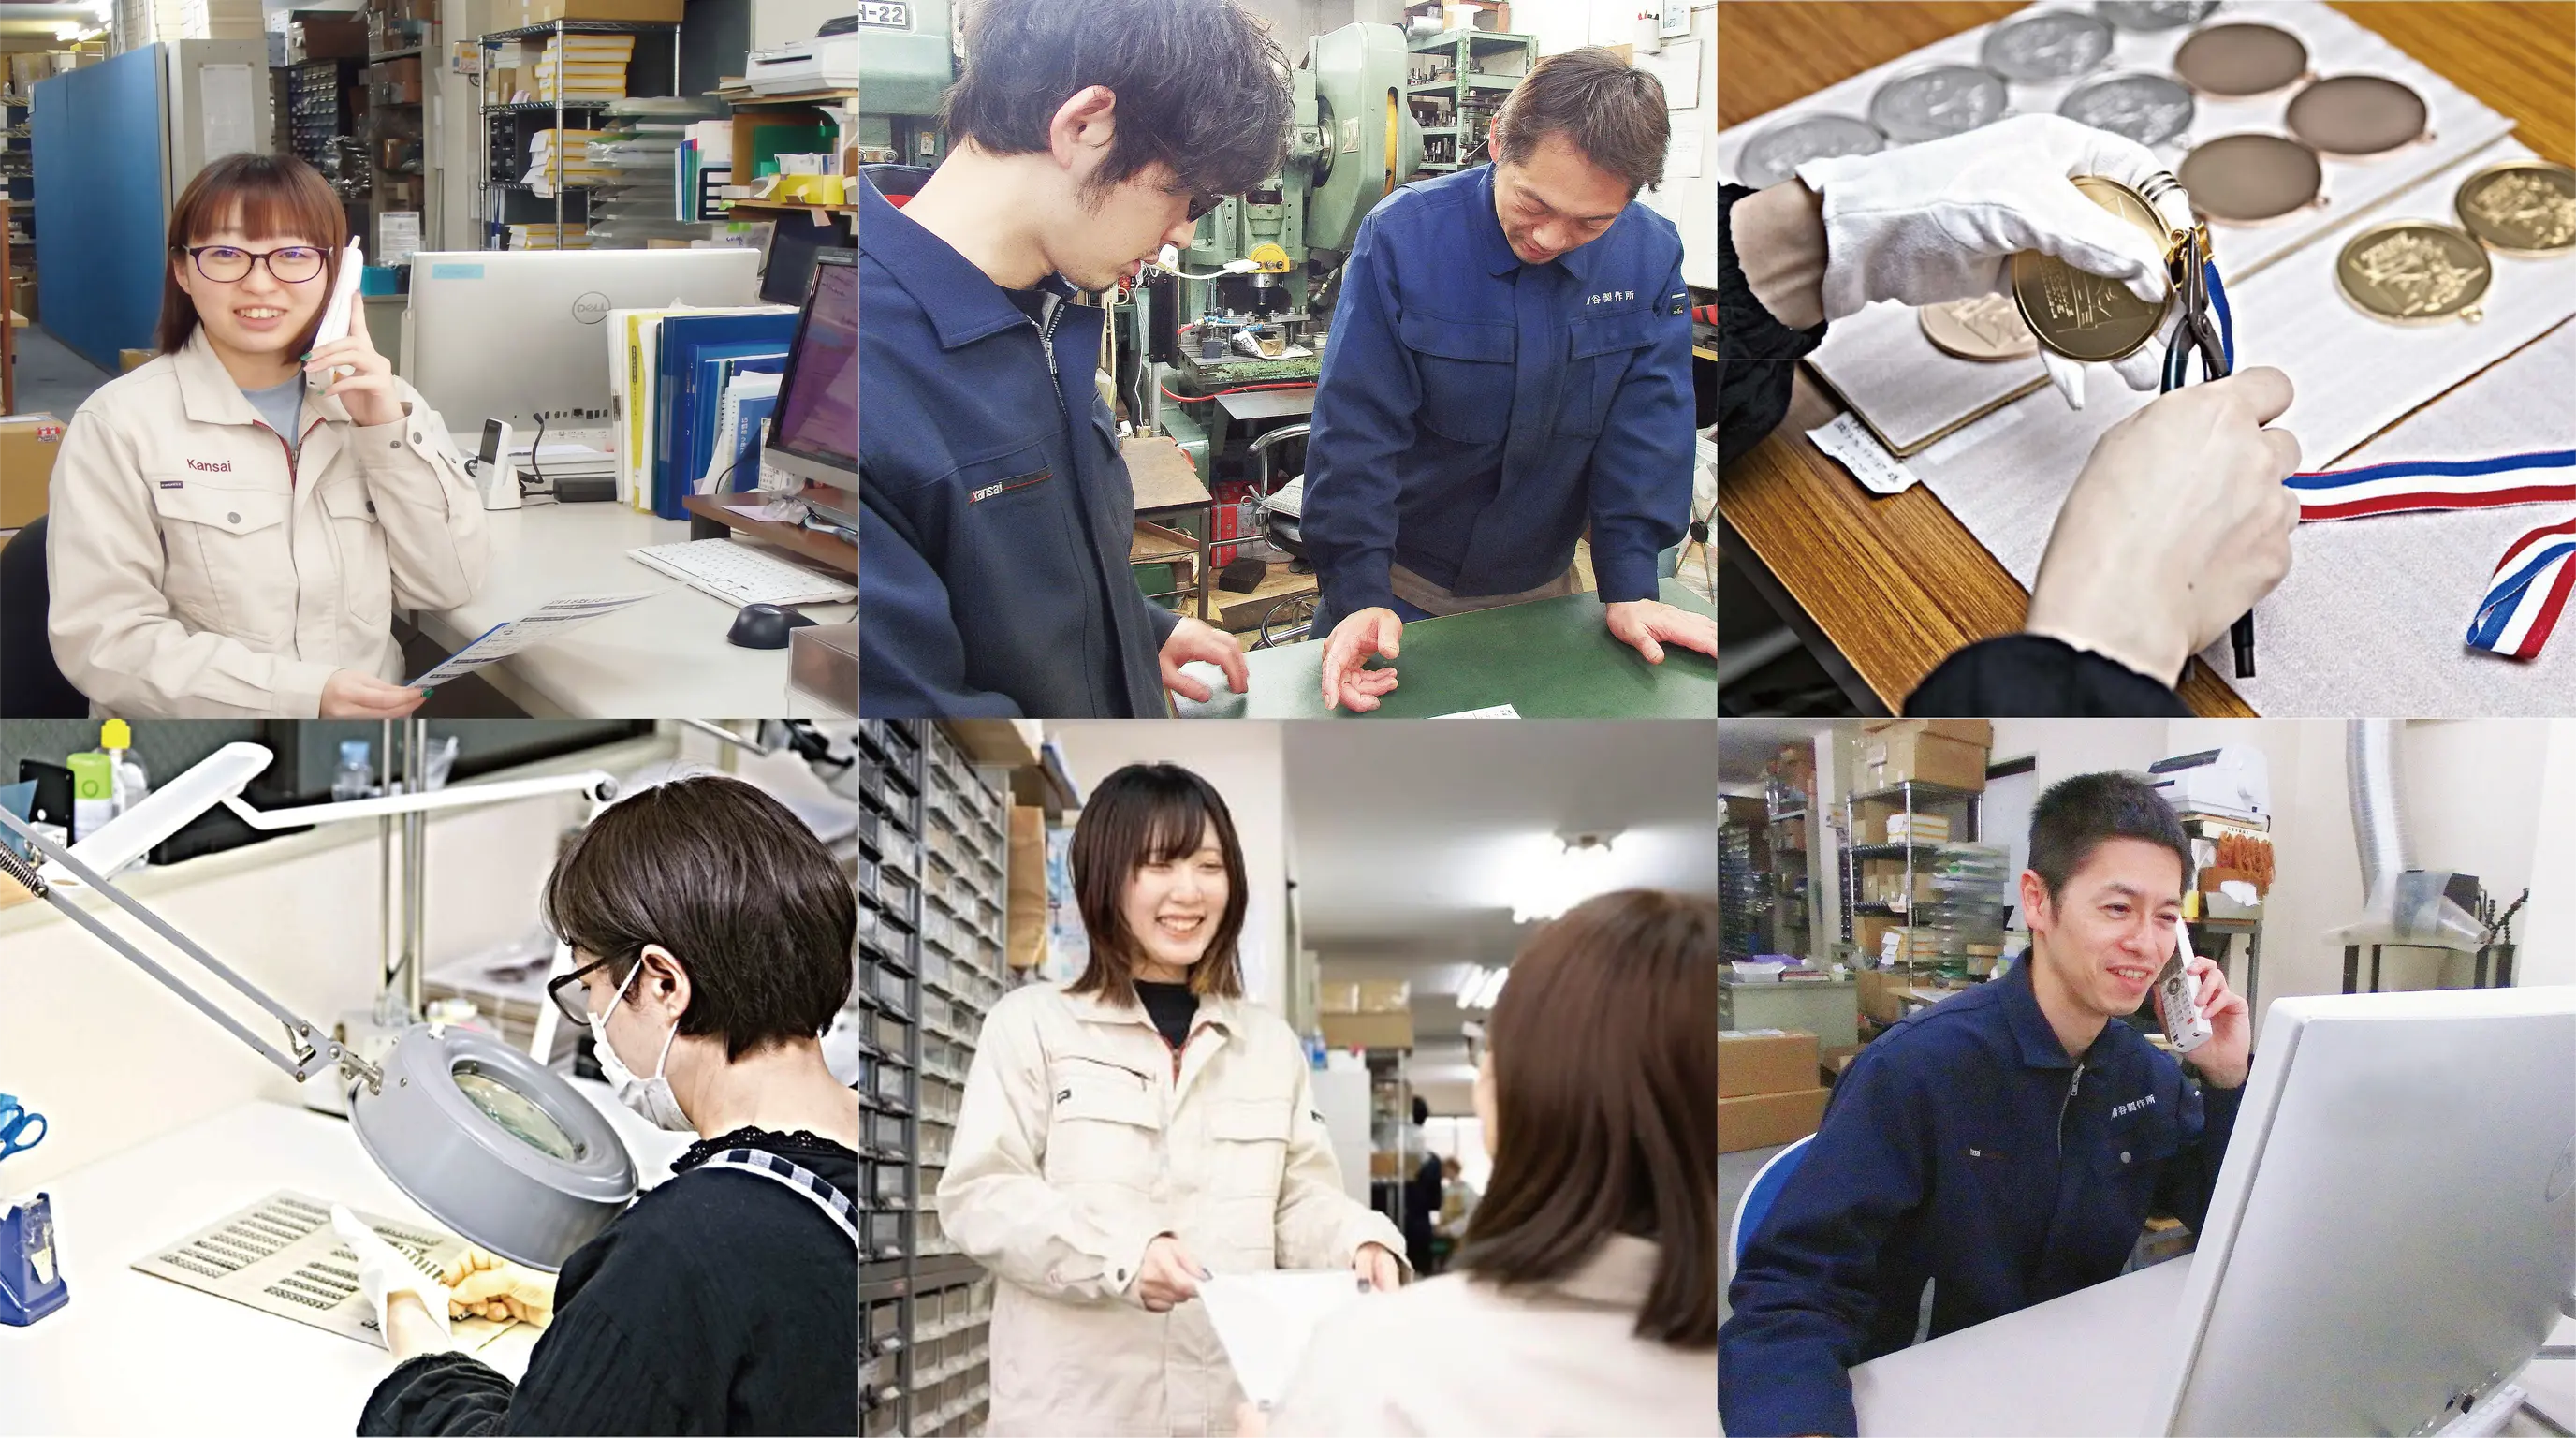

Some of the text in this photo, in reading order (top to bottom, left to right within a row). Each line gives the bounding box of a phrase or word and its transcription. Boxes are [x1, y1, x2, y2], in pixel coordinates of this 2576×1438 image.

[1586, 290, 1634, 305] 谷製作所
[187, 458, 231, 472] Kansai
